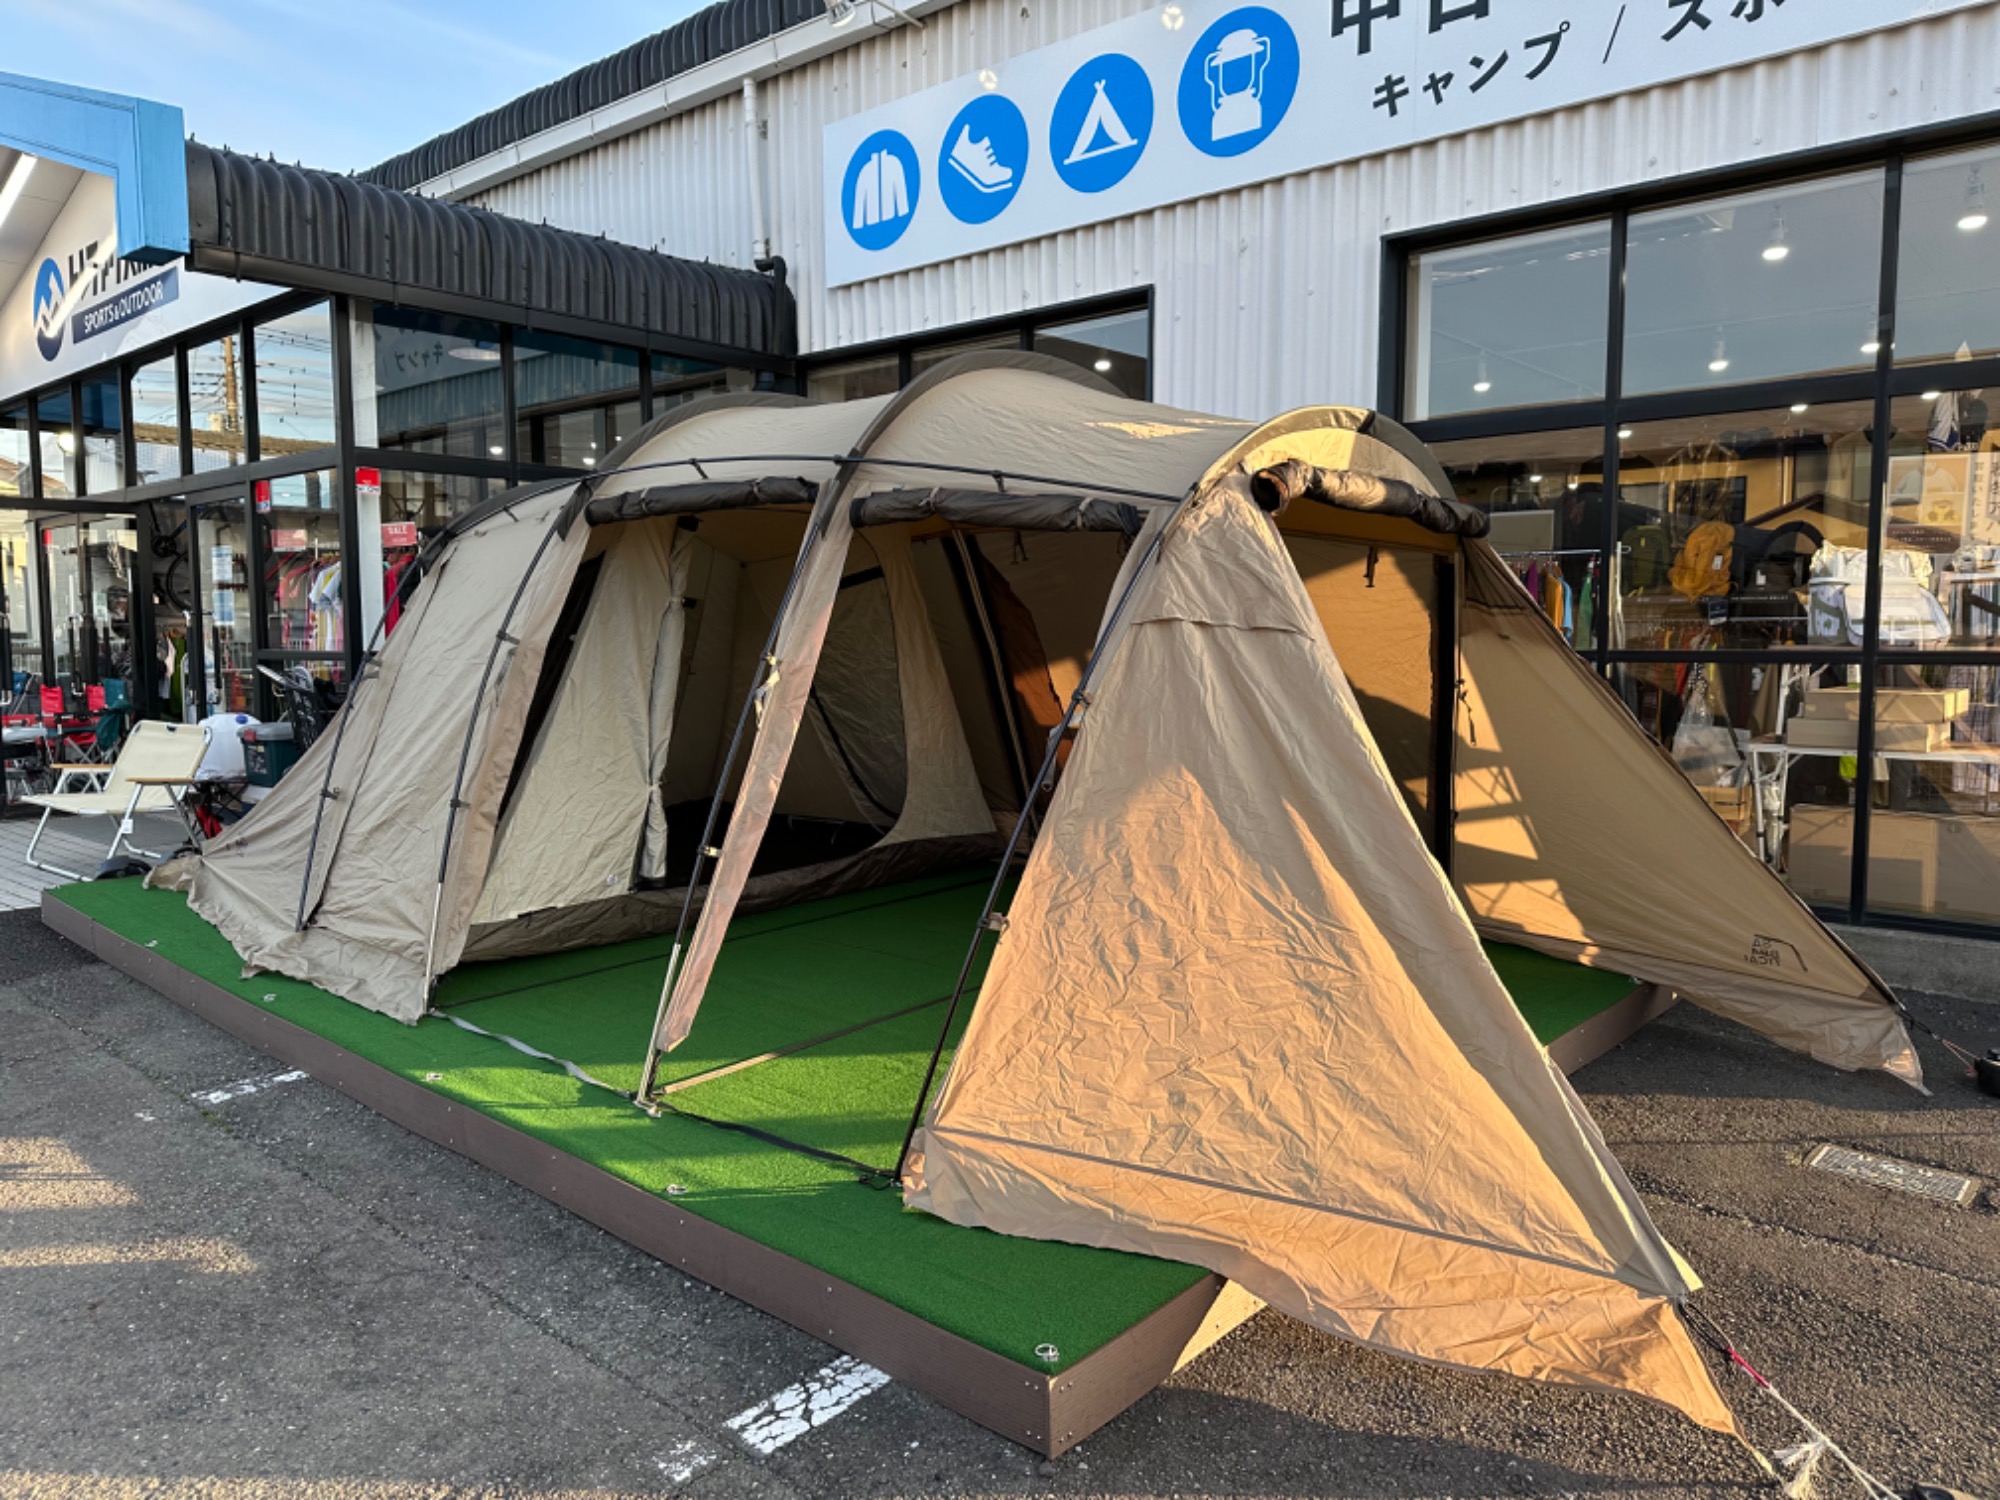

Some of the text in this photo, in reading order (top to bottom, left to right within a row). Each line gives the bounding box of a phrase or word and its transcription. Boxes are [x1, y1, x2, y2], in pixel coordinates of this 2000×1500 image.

[1372, 20, 1571, 118] キャンプ
[387, 525, 408, 535] SALE
